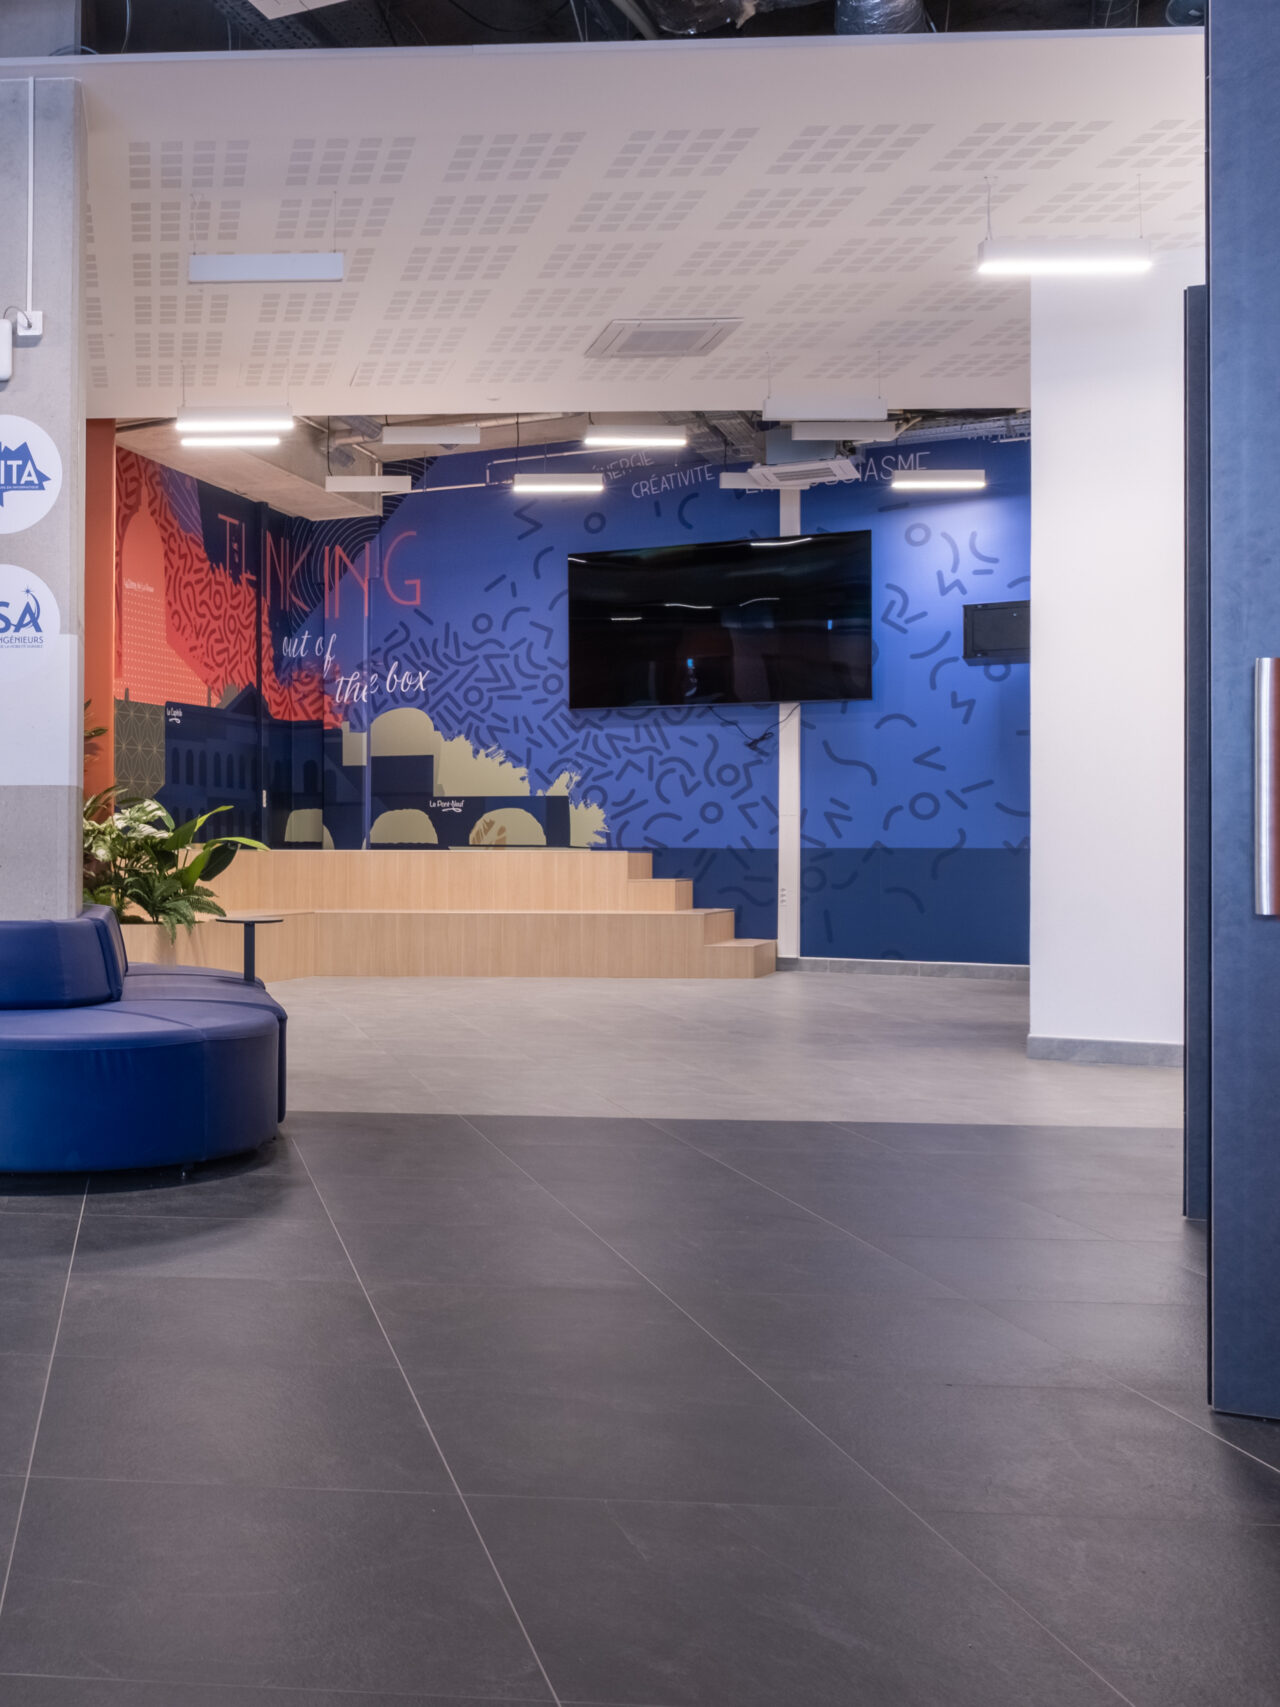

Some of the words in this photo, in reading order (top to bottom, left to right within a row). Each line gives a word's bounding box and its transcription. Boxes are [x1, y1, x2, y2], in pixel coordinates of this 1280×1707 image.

[282, 630, 311, 657] out
[315, 633, 337, 678] of
[335, 671, 378, 703] the
[386, 661, 430, 693] box
